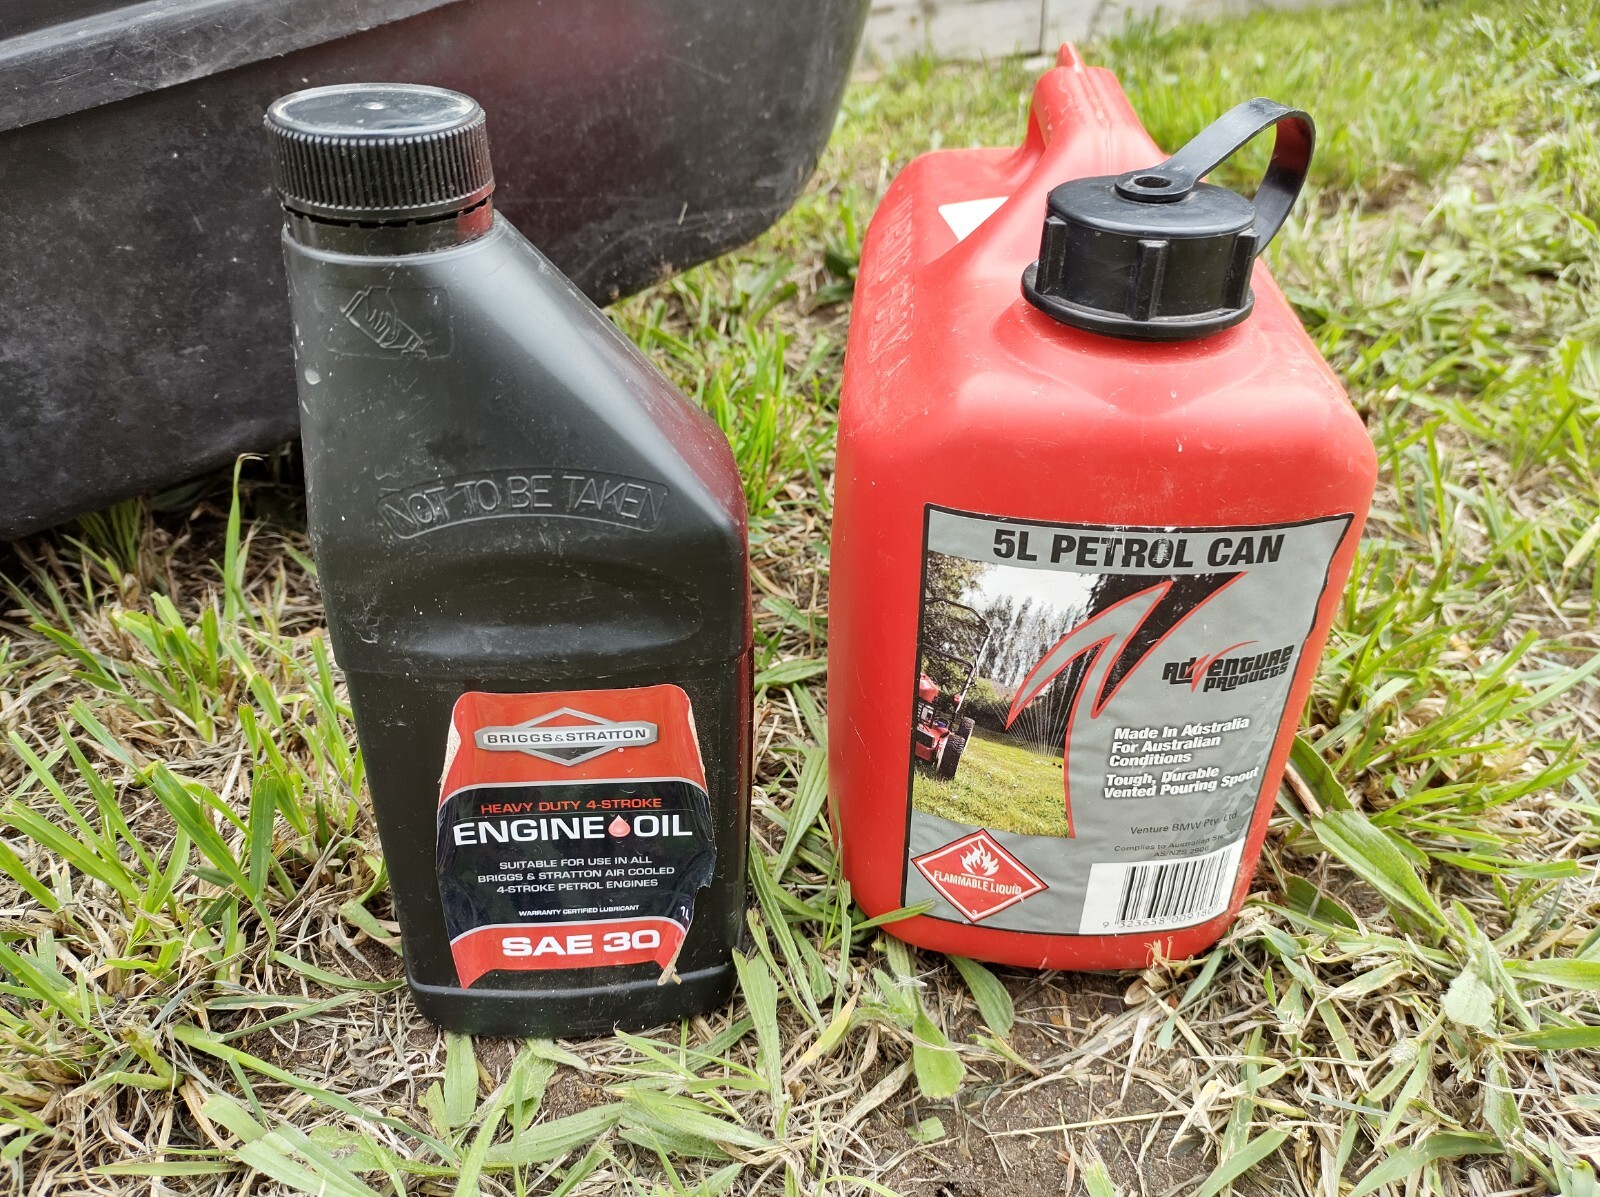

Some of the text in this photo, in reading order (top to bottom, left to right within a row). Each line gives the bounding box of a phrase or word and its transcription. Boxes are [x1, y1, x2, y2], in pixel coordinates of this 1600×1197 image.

[382, 475, 668, 527] NOT TO BE TAKEN
[992, 528, 1286, 568] 5L PETROL CAN
[1114, 717, 1250, 740] Made In Australia
[1112, 736, 1221, 753] For Australian
[1109, 752, 1192, 767] Conditions
[1104, 766, 1260, 798] Vented Pouring Spout
[1106, 766, 1220, 786] Tough, Durable
[480, 798, 662, 815] HEAVY DUTY 4-STROKE
[453, 814, 693, 847] ENGINE OIL
[1130, 825, 1169, 835] Venture
[1172, 821, 1202, 832] BMW
[499, 856, 653, 870] SUITABLE FOR USE IN ALL
[477, 866, 675, 883] BRIGGS & STRATTON AIR COOLED
[934, 870, 1022, 895] FLAMMABLE LIQUID
[496, 879, 658, 894] 4-STROKE PETROL ENGINES
[518, 904, 640, 917] WARRANTY CERTIFIED LUBRICANT
[1102, 921, 1110, 929] 9
[502, 929, 661, 957] SAE 30
